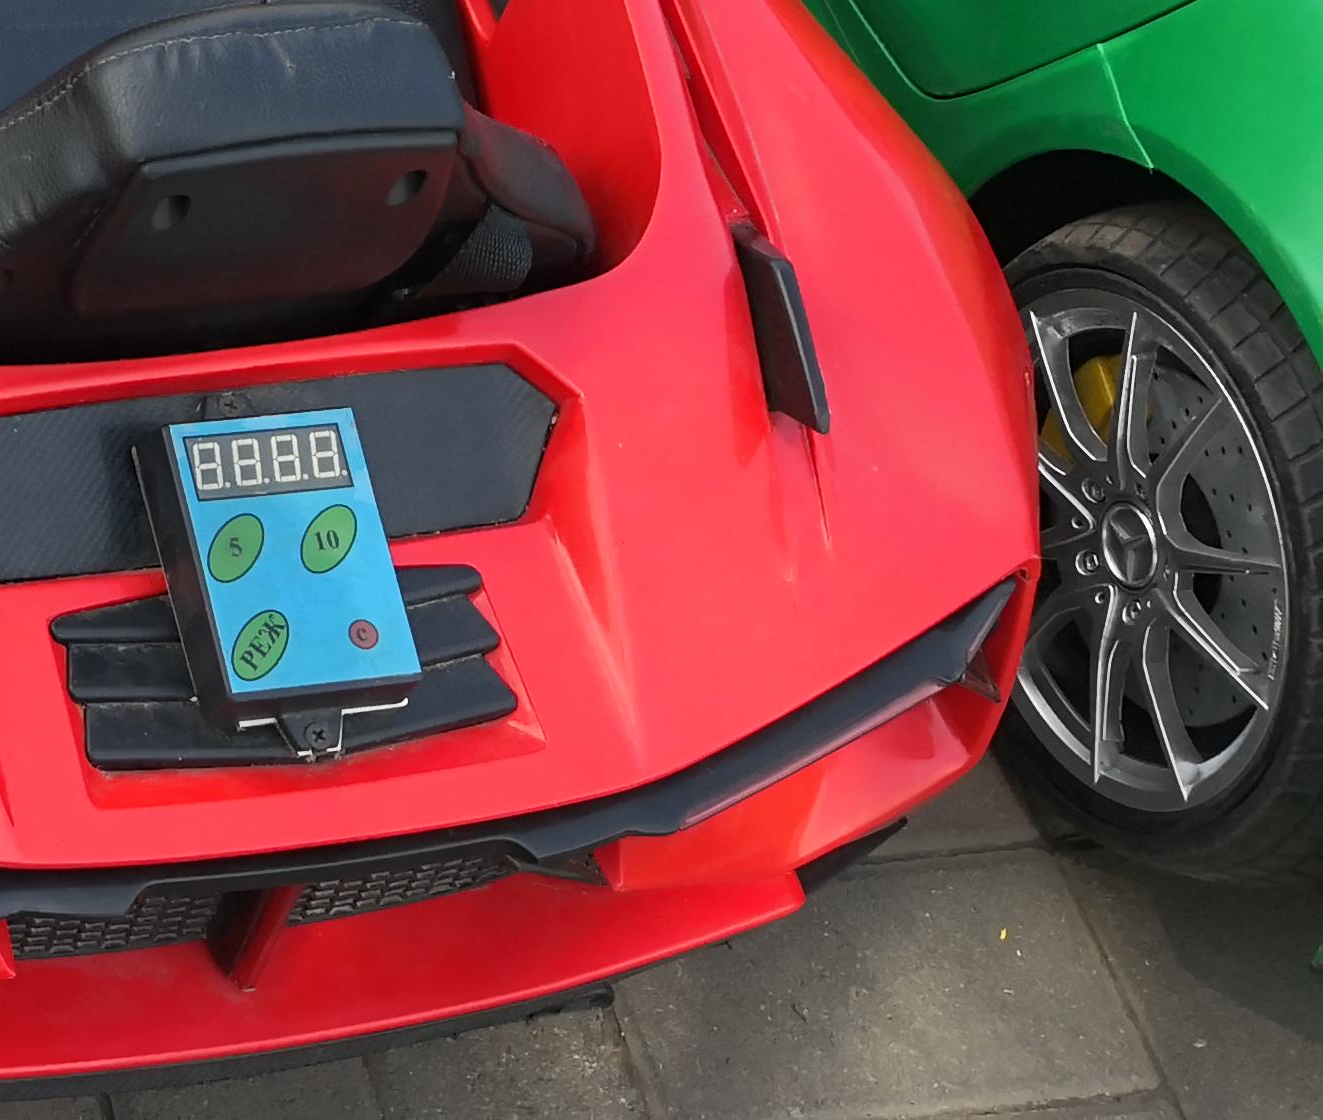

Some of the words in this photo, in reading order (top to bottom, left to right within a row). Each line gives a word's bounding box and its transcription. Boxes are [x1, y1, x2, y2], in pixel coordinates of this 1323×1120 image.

[228, 536, 243, 557] 5
[314, 529, 340, 552] 10
[239, 613, 287, 672] РЕЖ
